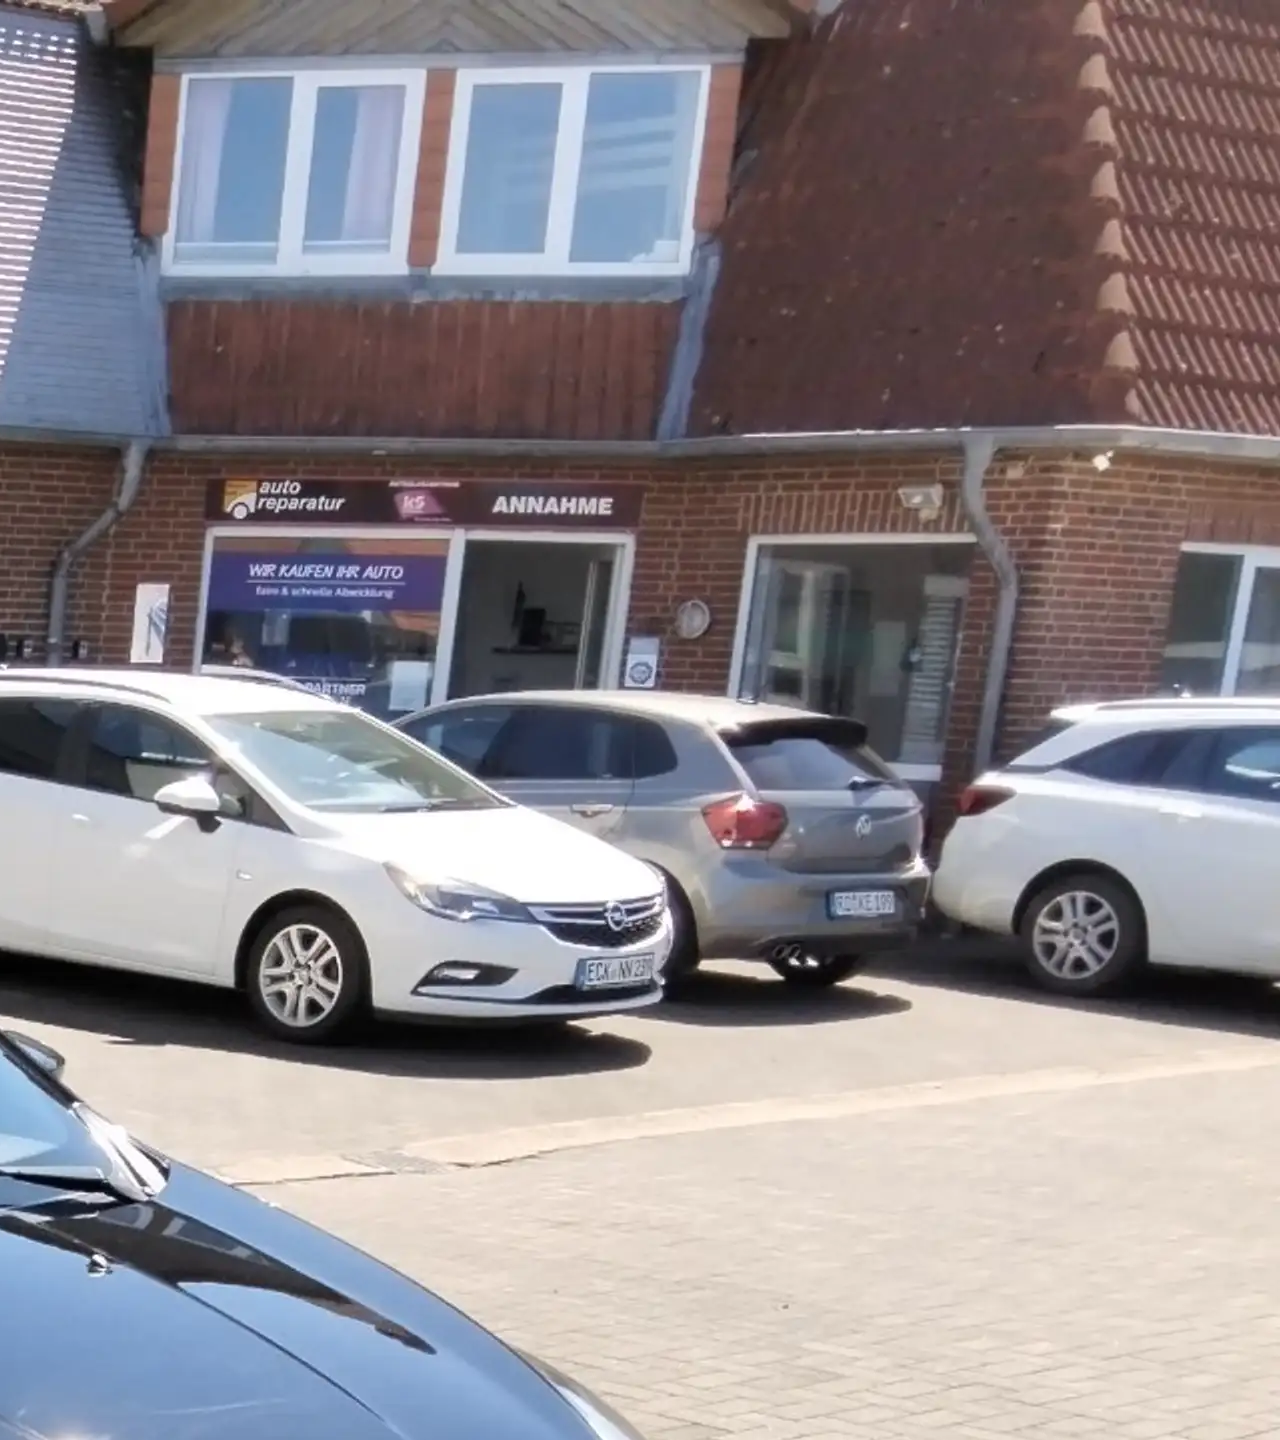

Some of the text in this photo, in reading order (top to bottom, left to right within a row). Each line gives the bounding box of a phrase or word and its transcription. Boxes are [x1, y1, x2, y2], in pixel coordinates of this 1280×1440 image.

[259, 480, 302, 495] auto
[257, 495, 346, 512] reparatur
[491, 496, 614, 515] ANNAHME
[249, 563, 404, 580] WIR KAUFEN IHR AUTO
